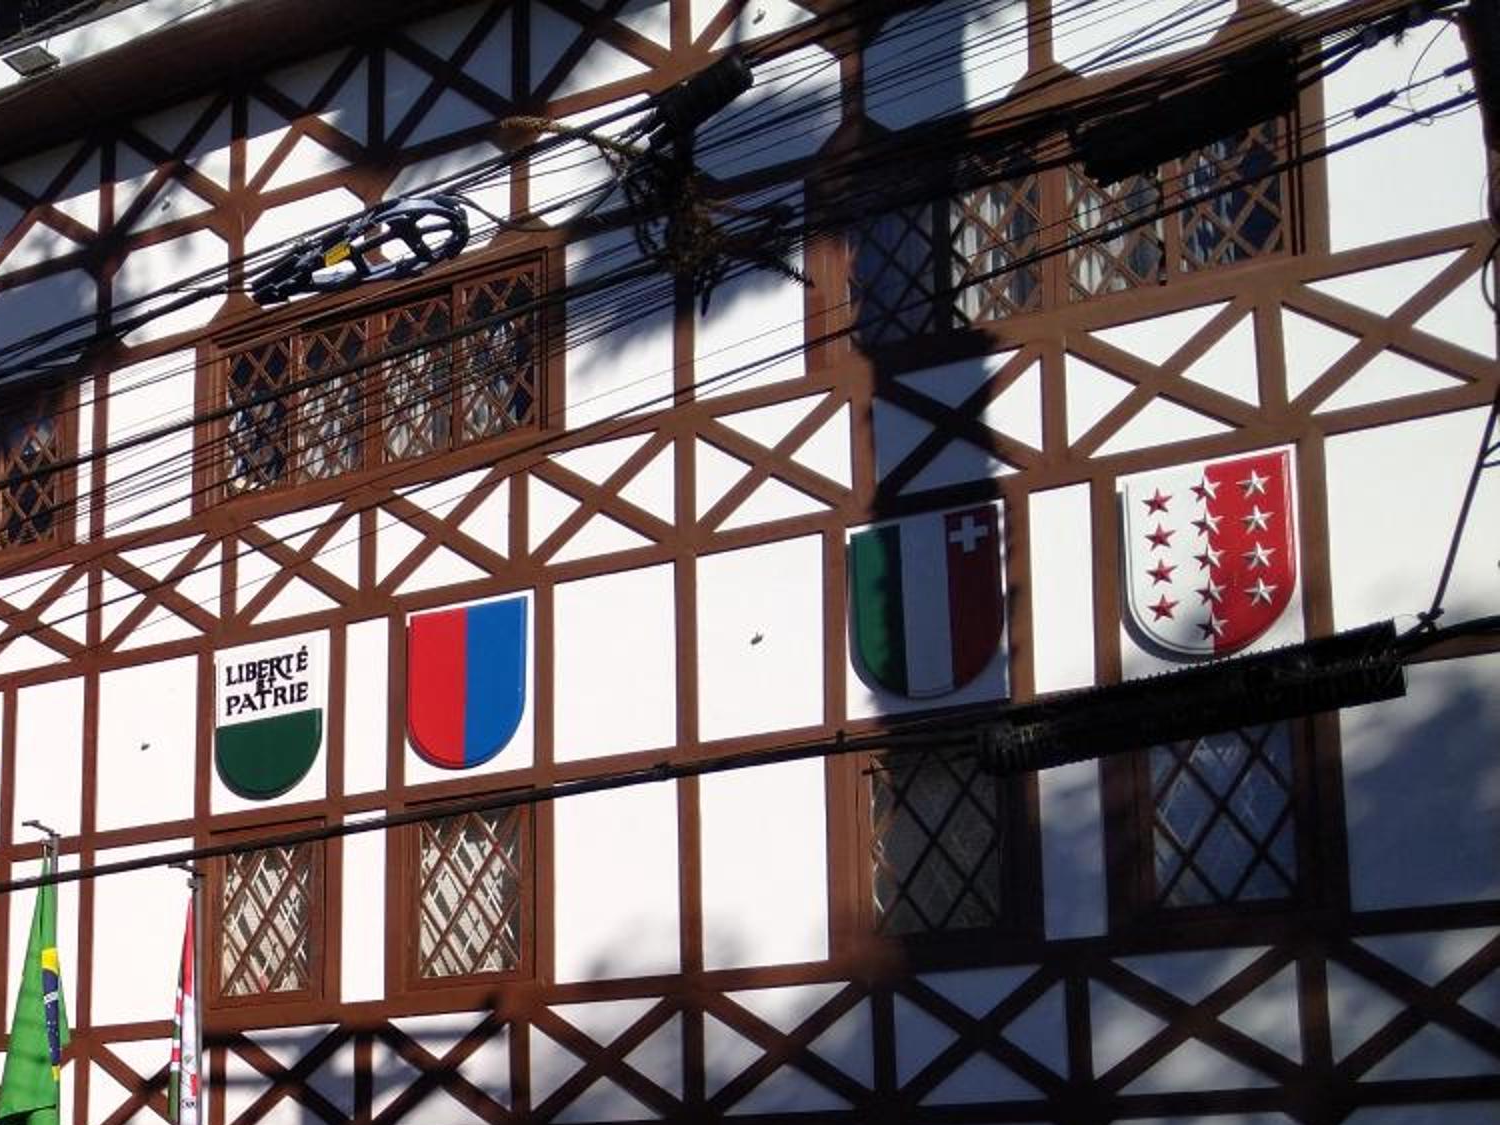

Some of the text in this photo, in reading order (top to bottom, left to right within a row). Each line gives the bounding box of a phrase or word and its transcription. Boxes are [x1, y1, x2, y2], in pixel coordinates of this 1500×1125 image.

[225, 645, 309, 687] LIBERTÉ
[225, 681, 309, 717] PATRIE
[255, 677, 277, 694] ET
